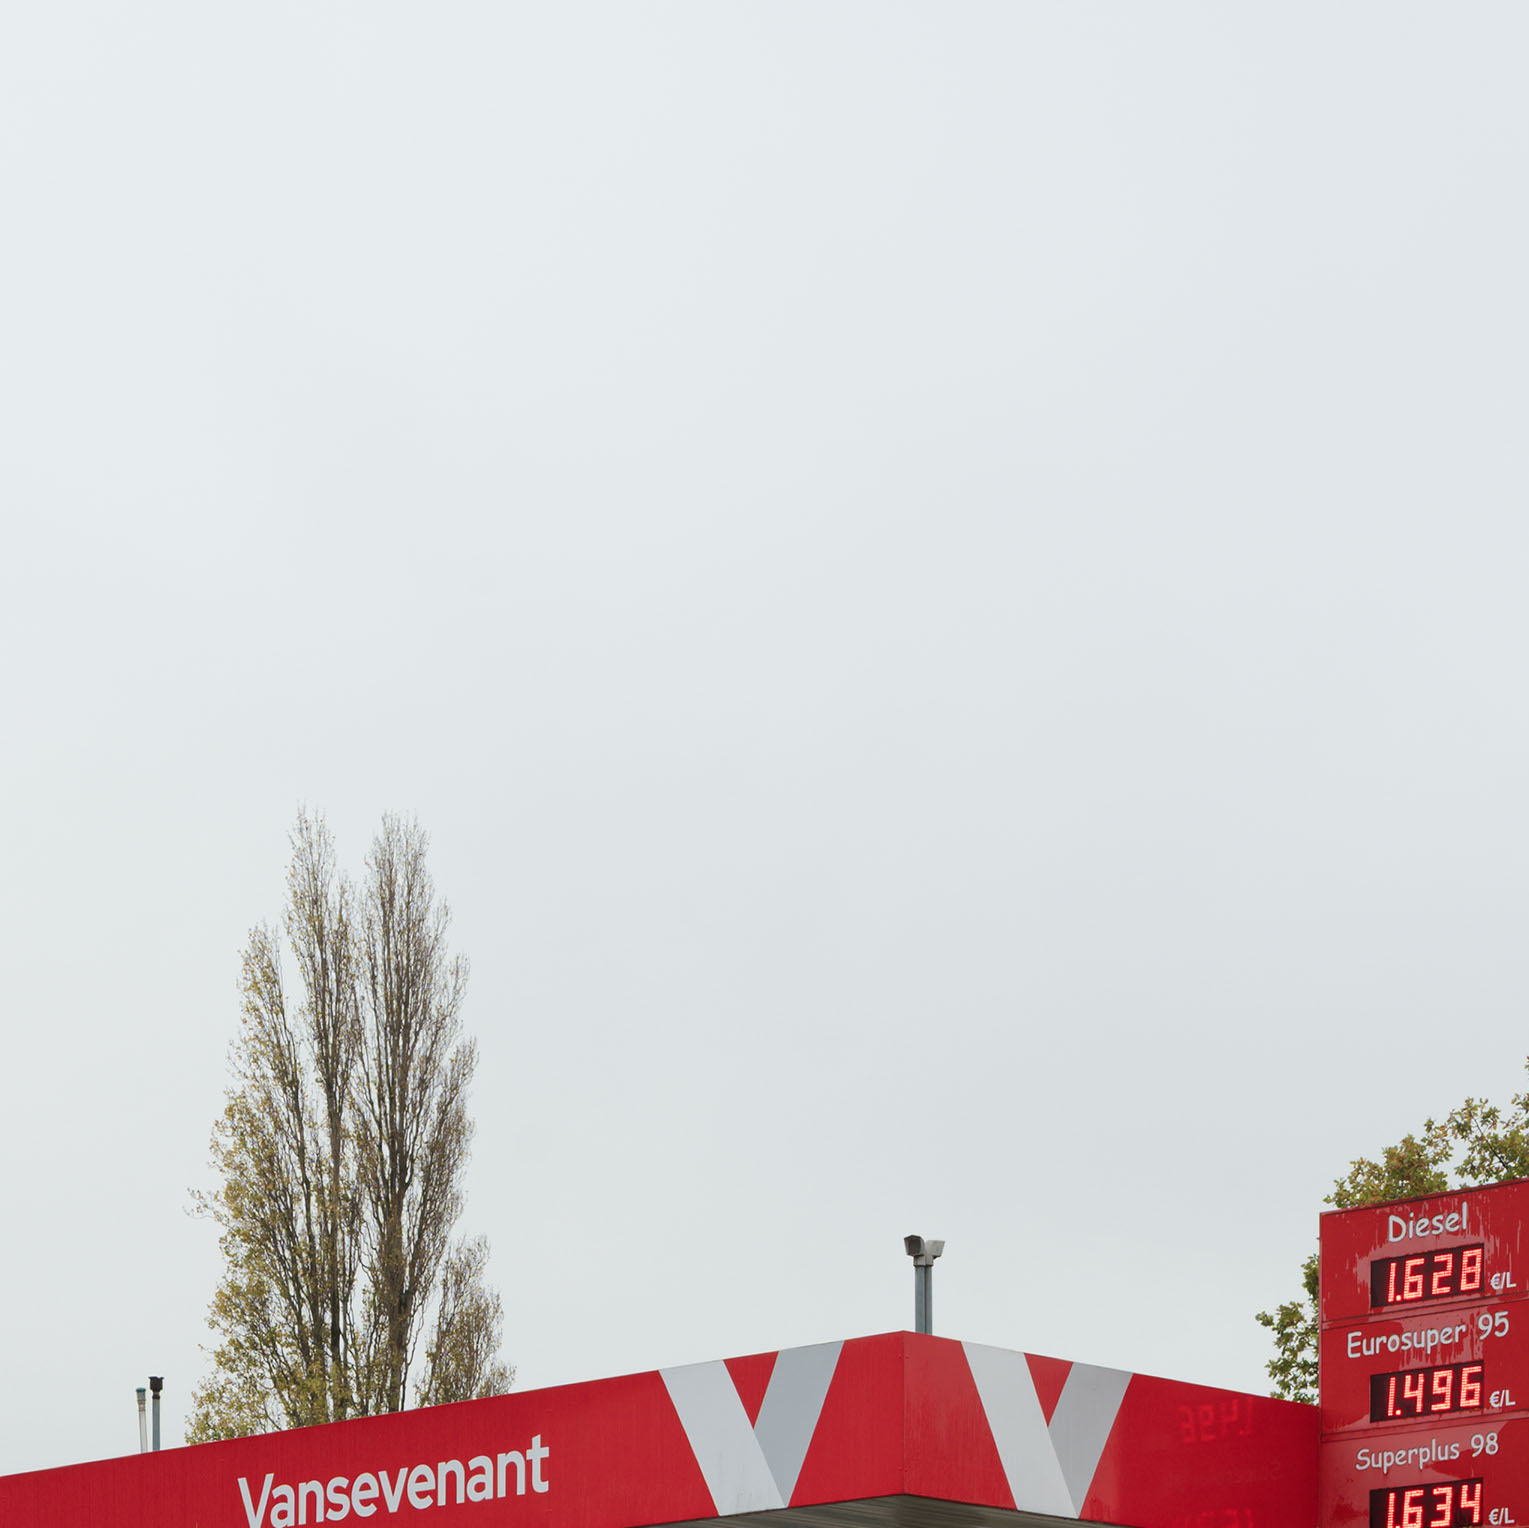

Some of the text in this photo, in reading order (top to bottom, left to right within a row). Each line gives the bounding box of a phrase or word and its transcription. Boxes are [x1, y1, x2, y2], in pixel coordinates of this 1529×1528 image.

[1388, 1202, 1467, 1243] Diesel
[1387, 1247, 1517, 1303] 1.628 €/L
[1347, 1311, 1509, 1359] Eurosuper 95
[1387, 1364, 1516, 1417] 1.496 €/L
[1355, 1432, 1499, 1474] Superplus 98
[1488, 1507, 1515, 1525] €/L
